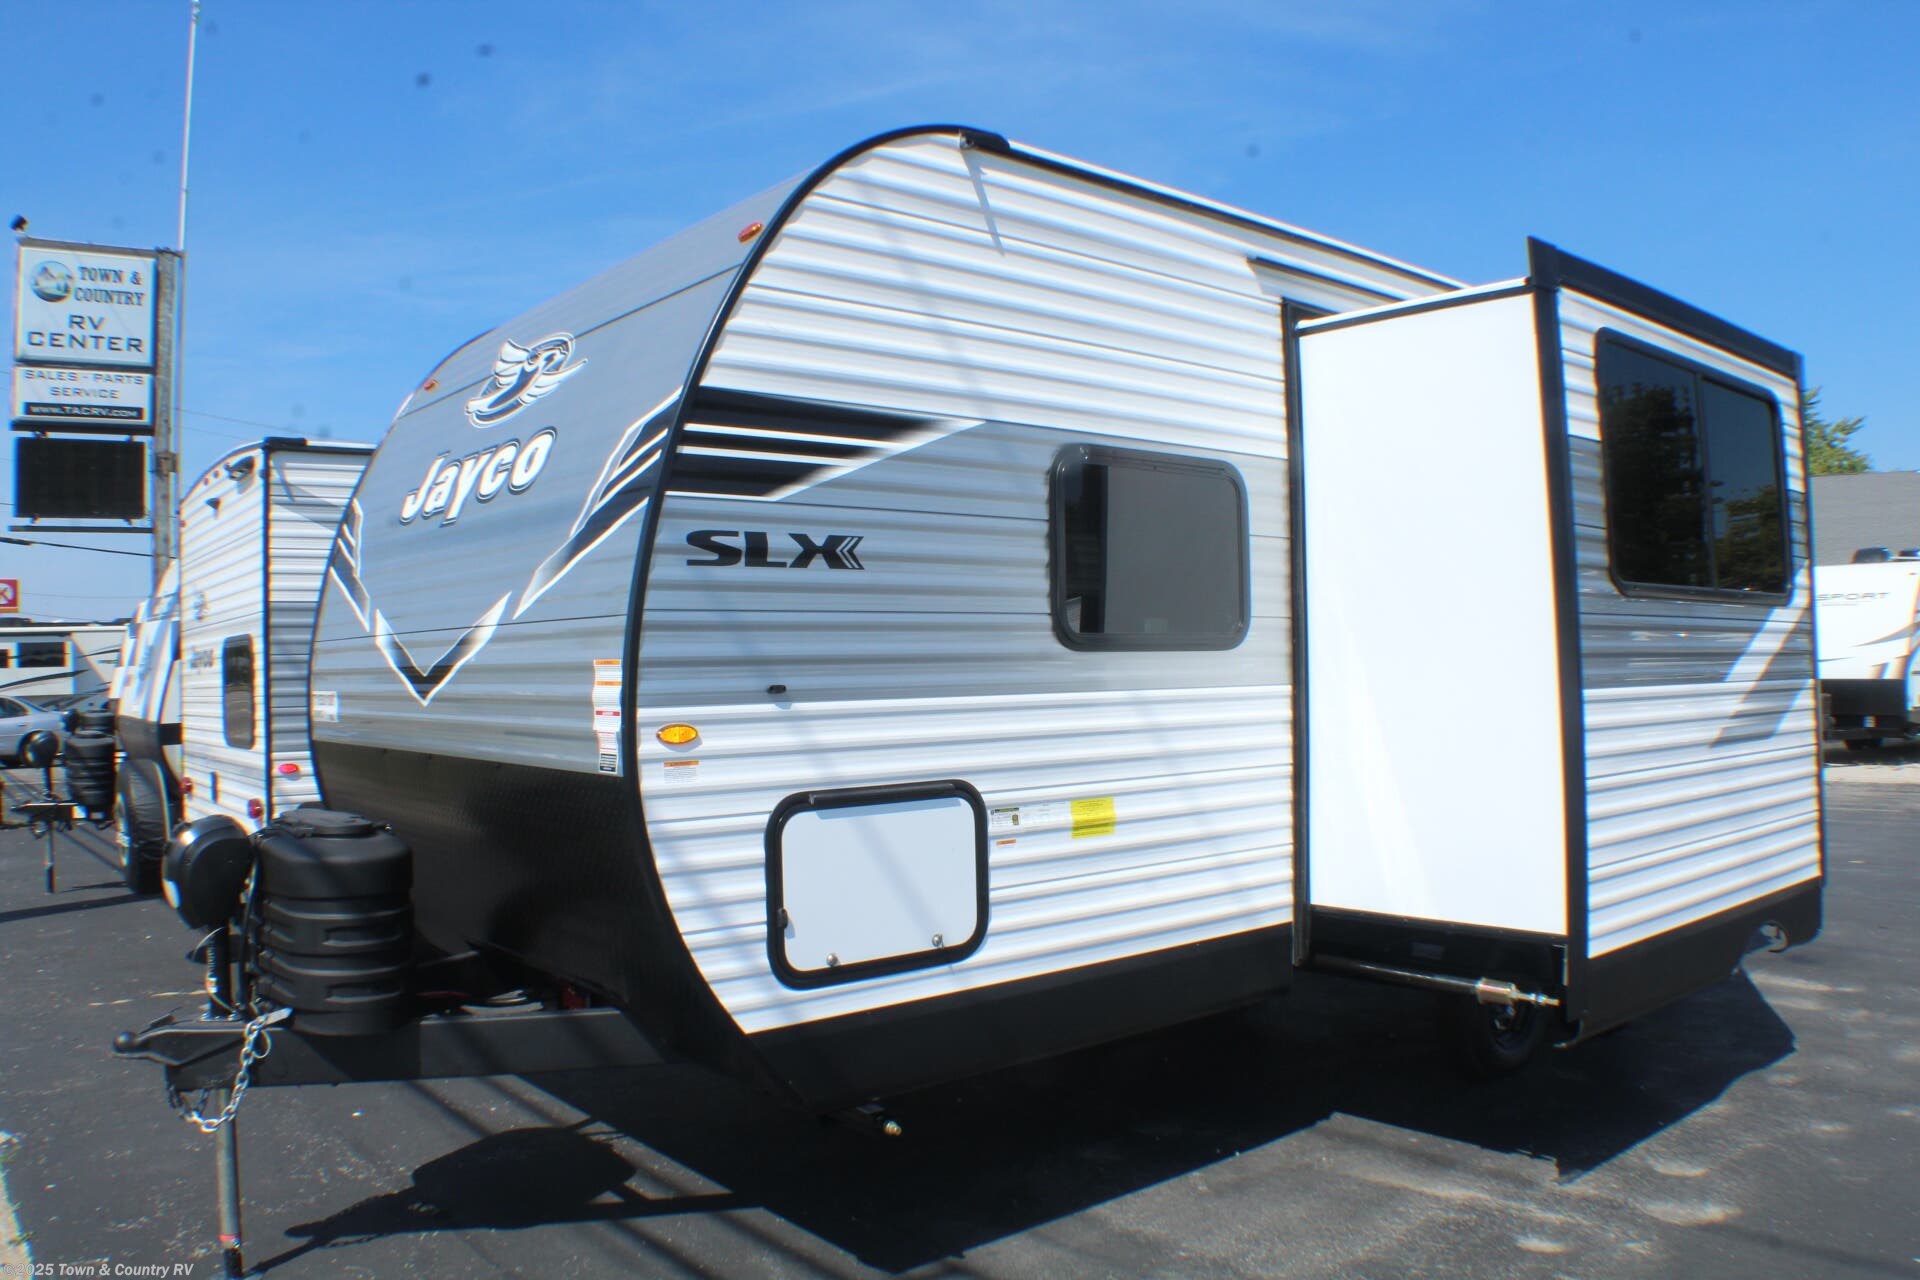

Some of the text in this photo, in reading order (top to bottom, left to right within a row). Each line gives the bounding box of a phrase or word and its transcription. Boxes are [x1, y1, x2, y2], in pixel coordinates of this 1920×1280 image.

[77, 266, 142, 285] TOWN &
[73, 287, 145, 306] COUNTRY
[68, 314, 106, 330] RV
[27, 331, 145, 353] CENTER
[24, 369, 78, 381] SALES
[93, 373, 145, 385] PARTS
[50, 386, 119, 399] SERVICE
[400, 426, 557, 528] Jayco
[686, 530, 865, 570] SLX
